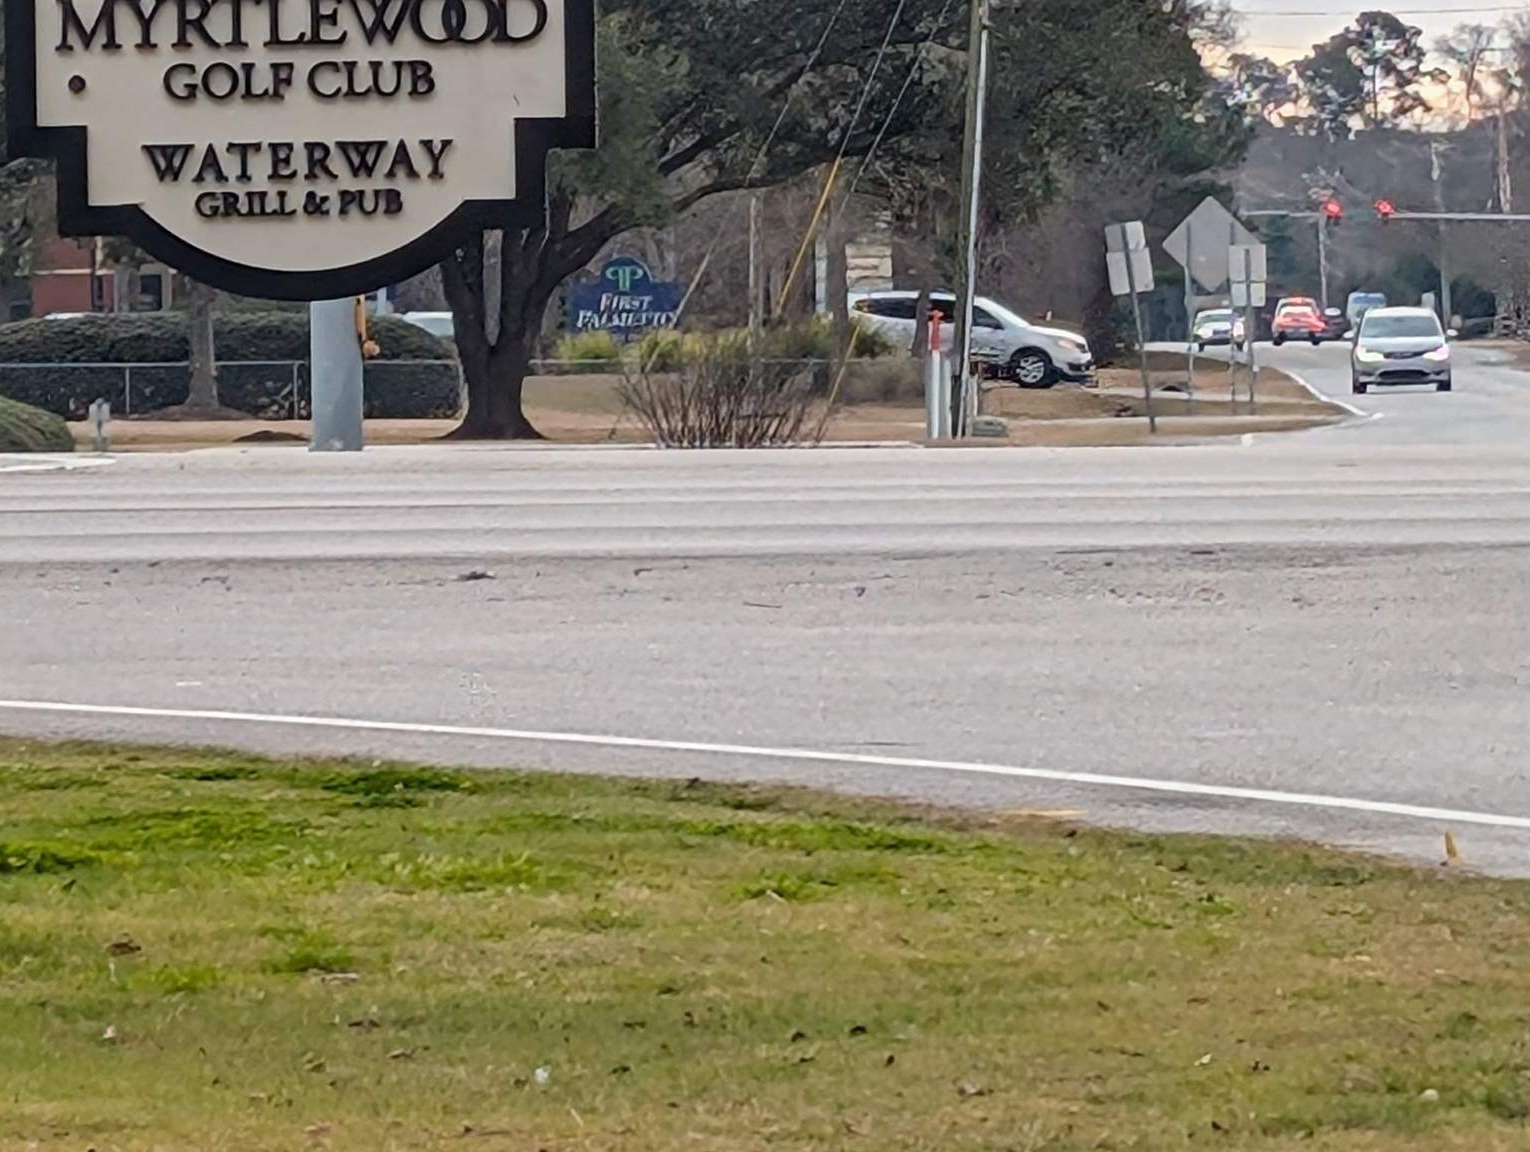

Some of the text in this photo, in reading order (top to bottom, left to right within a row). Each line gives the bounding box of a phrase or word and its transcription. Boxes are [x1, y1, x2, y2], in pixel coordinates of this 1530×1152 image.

[163, 60, 436, 100] GOLF CLUB
[141, 139, 453, 182] WATERWAY
[195, 189, 403, 218] GRILL & PUB
